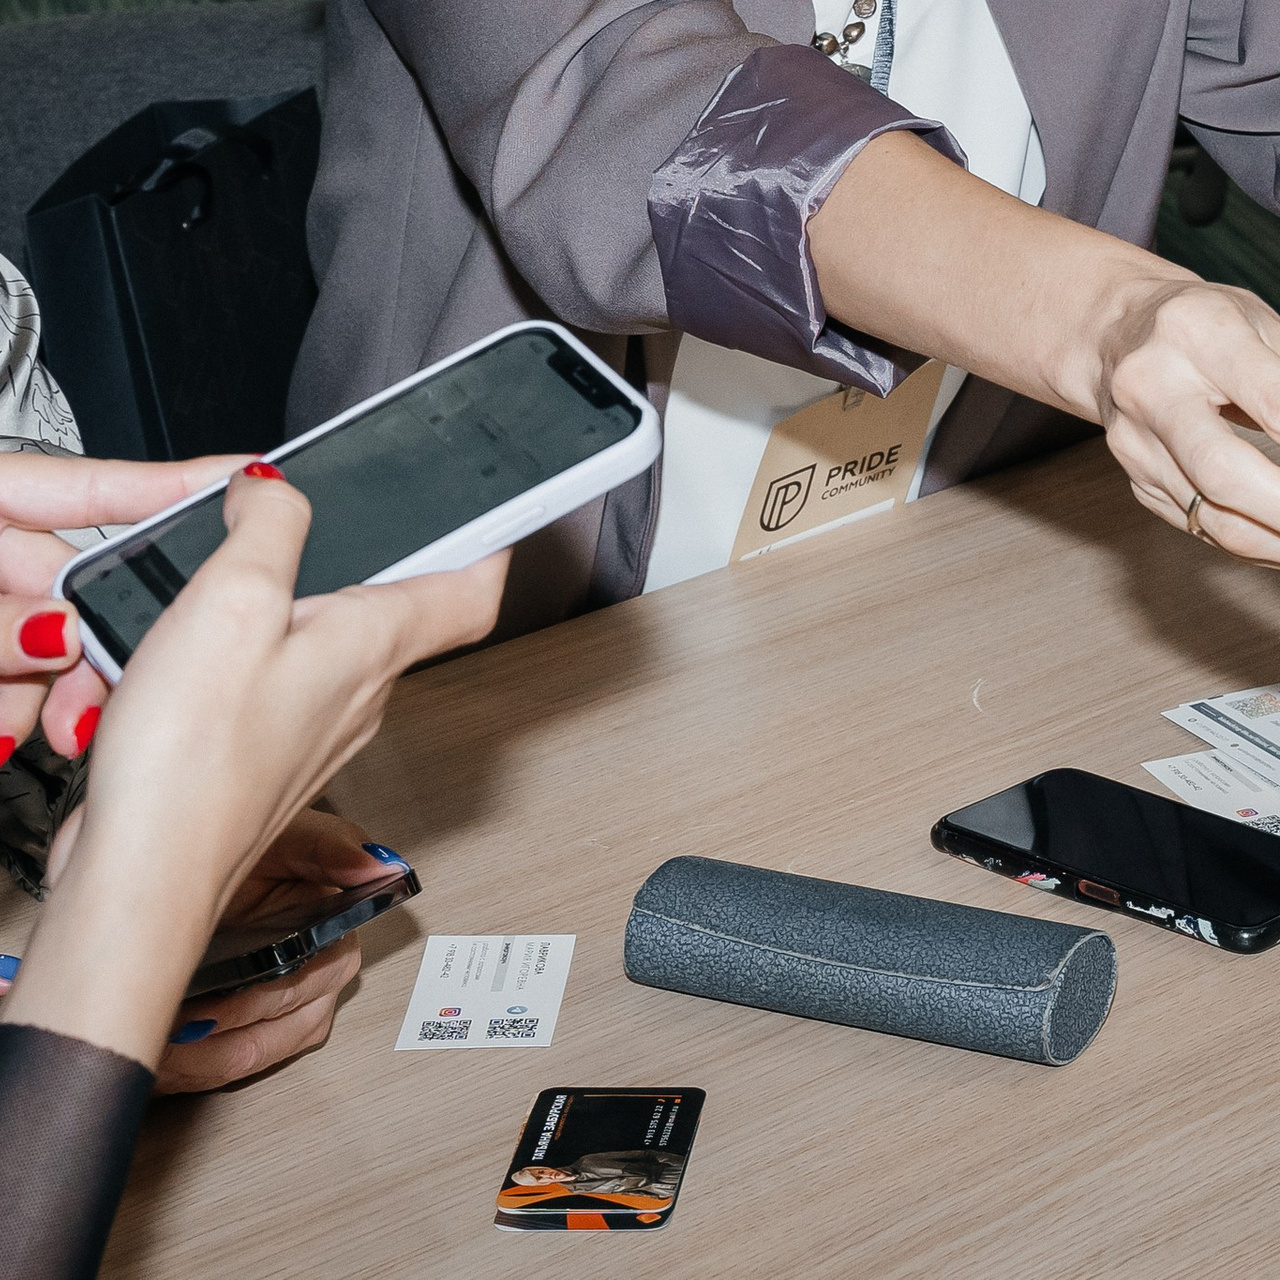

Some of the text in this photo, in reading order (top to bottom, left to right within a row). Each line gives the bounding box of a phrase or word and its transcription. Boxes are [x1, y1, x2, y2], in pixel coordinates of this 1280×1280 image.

[825, 443, 902, 487] PRIDE
[821, 466, 897, 501] COMMUNITY
[532, 941, 552, 975] ЛАВРИКОВА
[531, 1131, 553, 1160] ТАТЬЯНА
[542, 1094, 568, 1130] ЗАБУРСКАЯ
[644, 1129, 656, 1138] 913
[647, 1119, 660, 1128] 575
